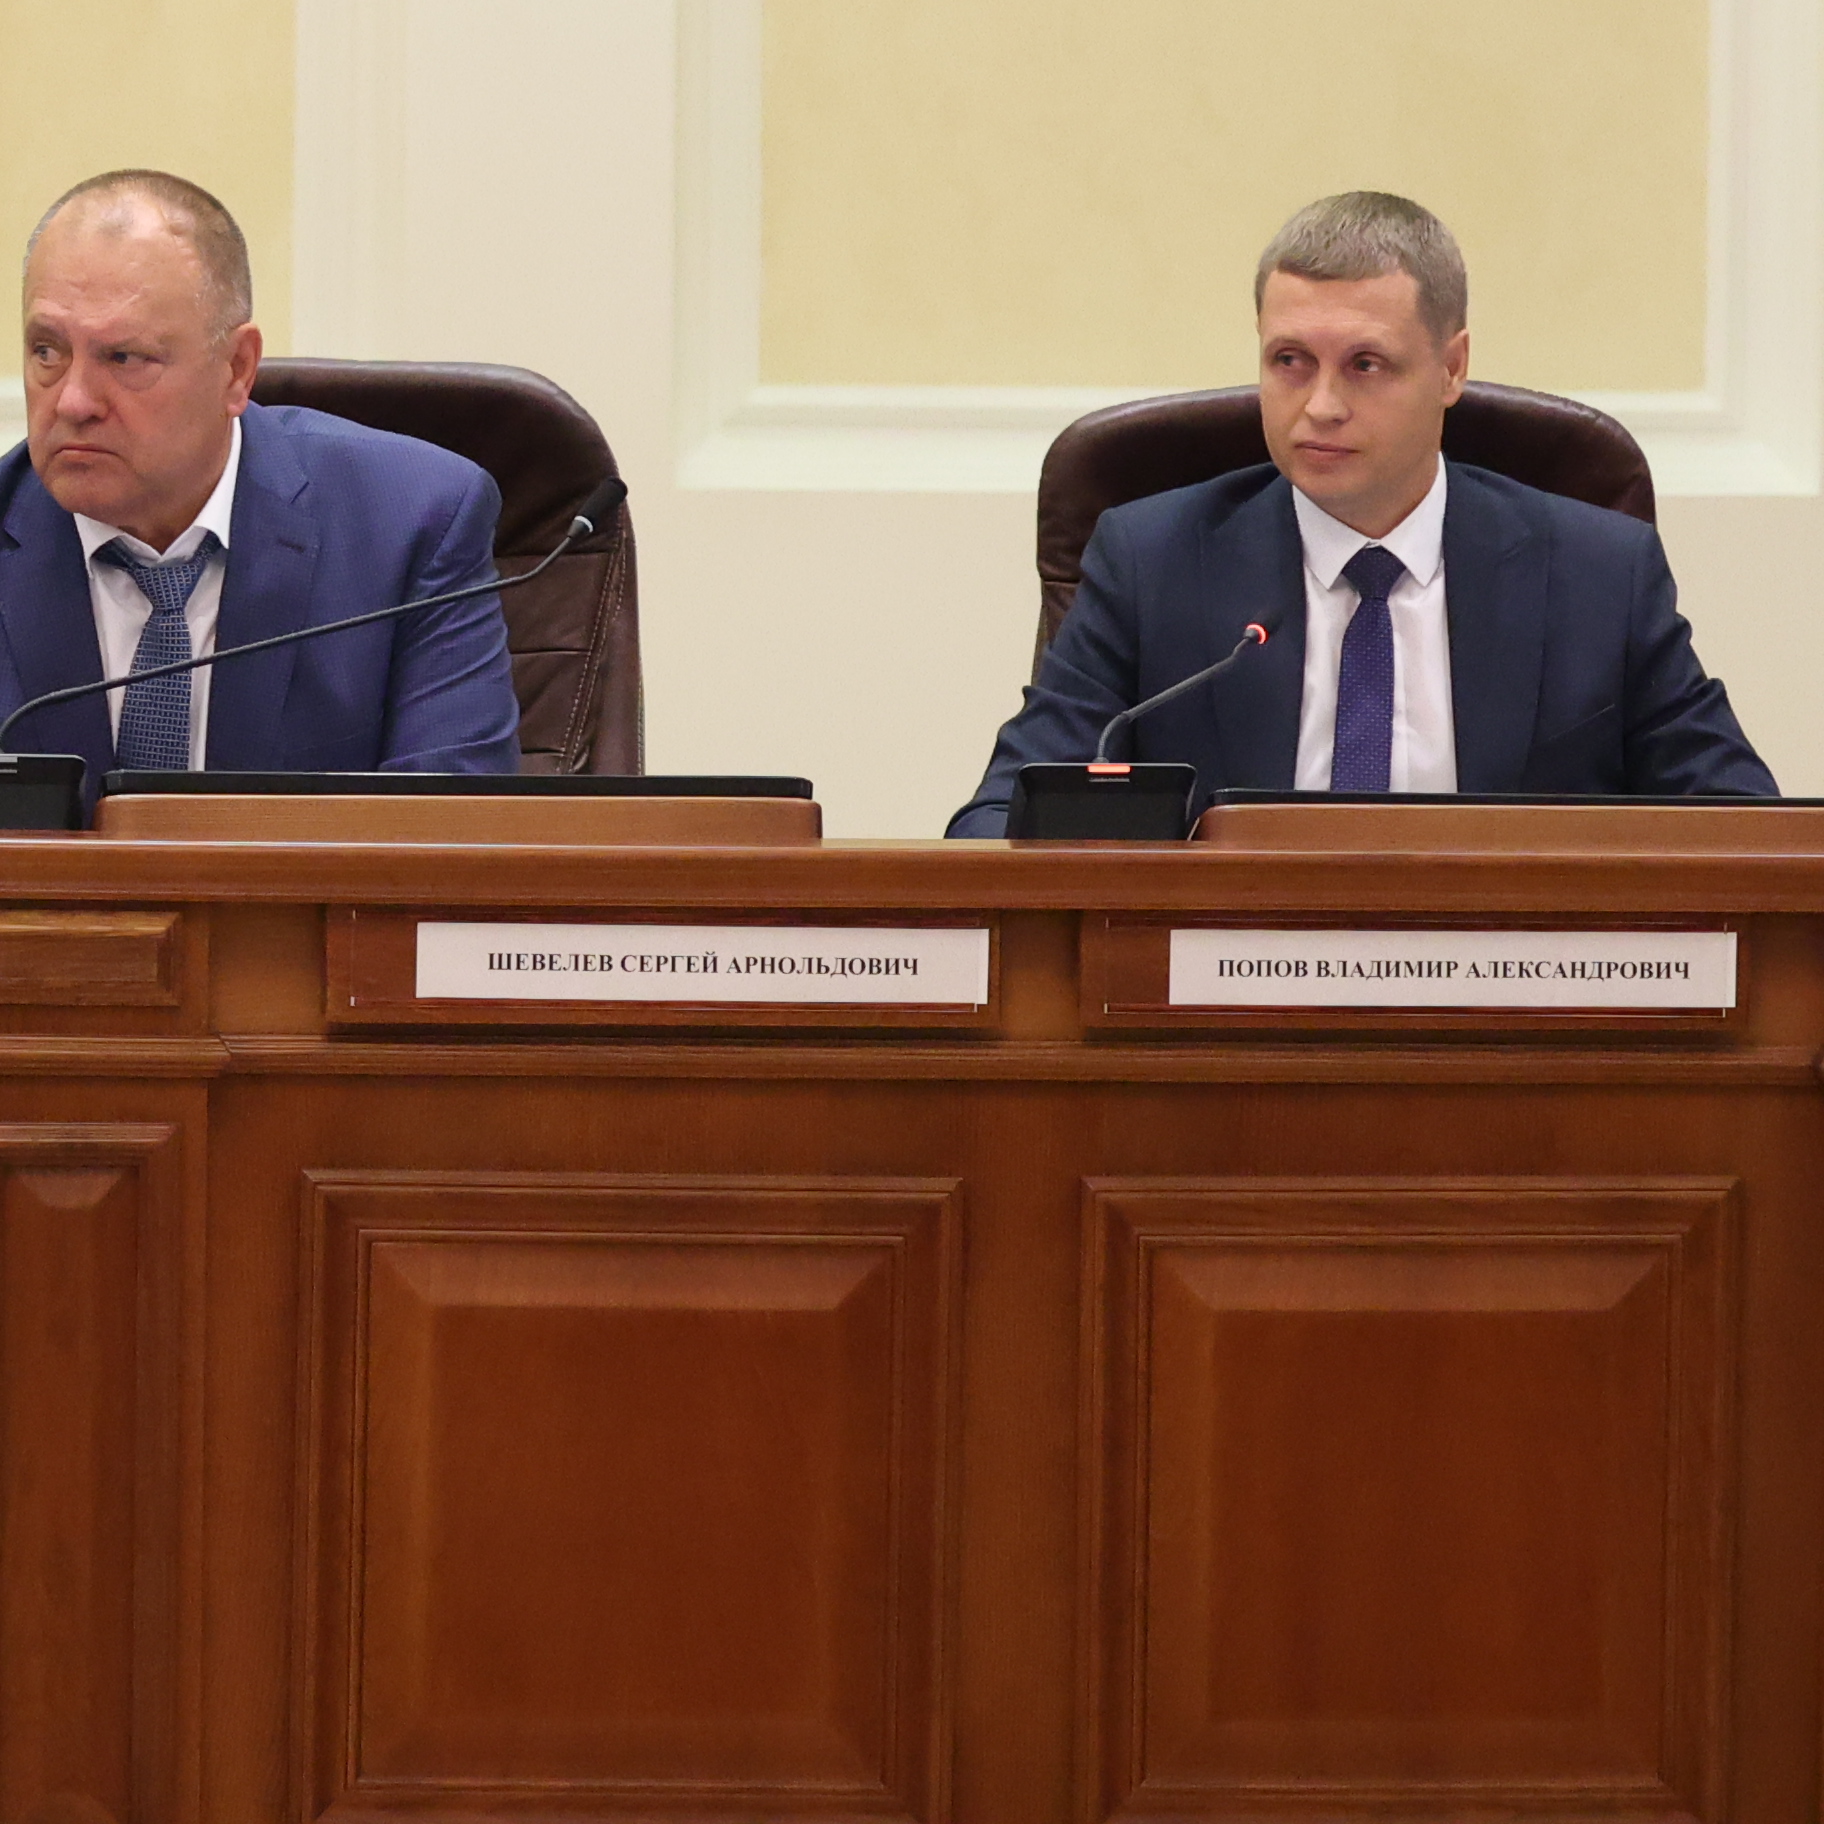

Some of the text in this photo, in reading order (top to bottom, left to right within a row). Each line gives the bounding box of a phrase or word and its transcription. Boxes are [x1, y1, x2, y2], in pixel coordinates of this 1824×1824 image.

[489, 951, 918, 978] ШЕВЕЛЕВ СЕРГЕЙ АРНОЛЬДОВИЧ
[1219, 960, 1689, 981] ПОПОВ ВЛАДИМИР АЛЕКСАНДРОВИЧ
